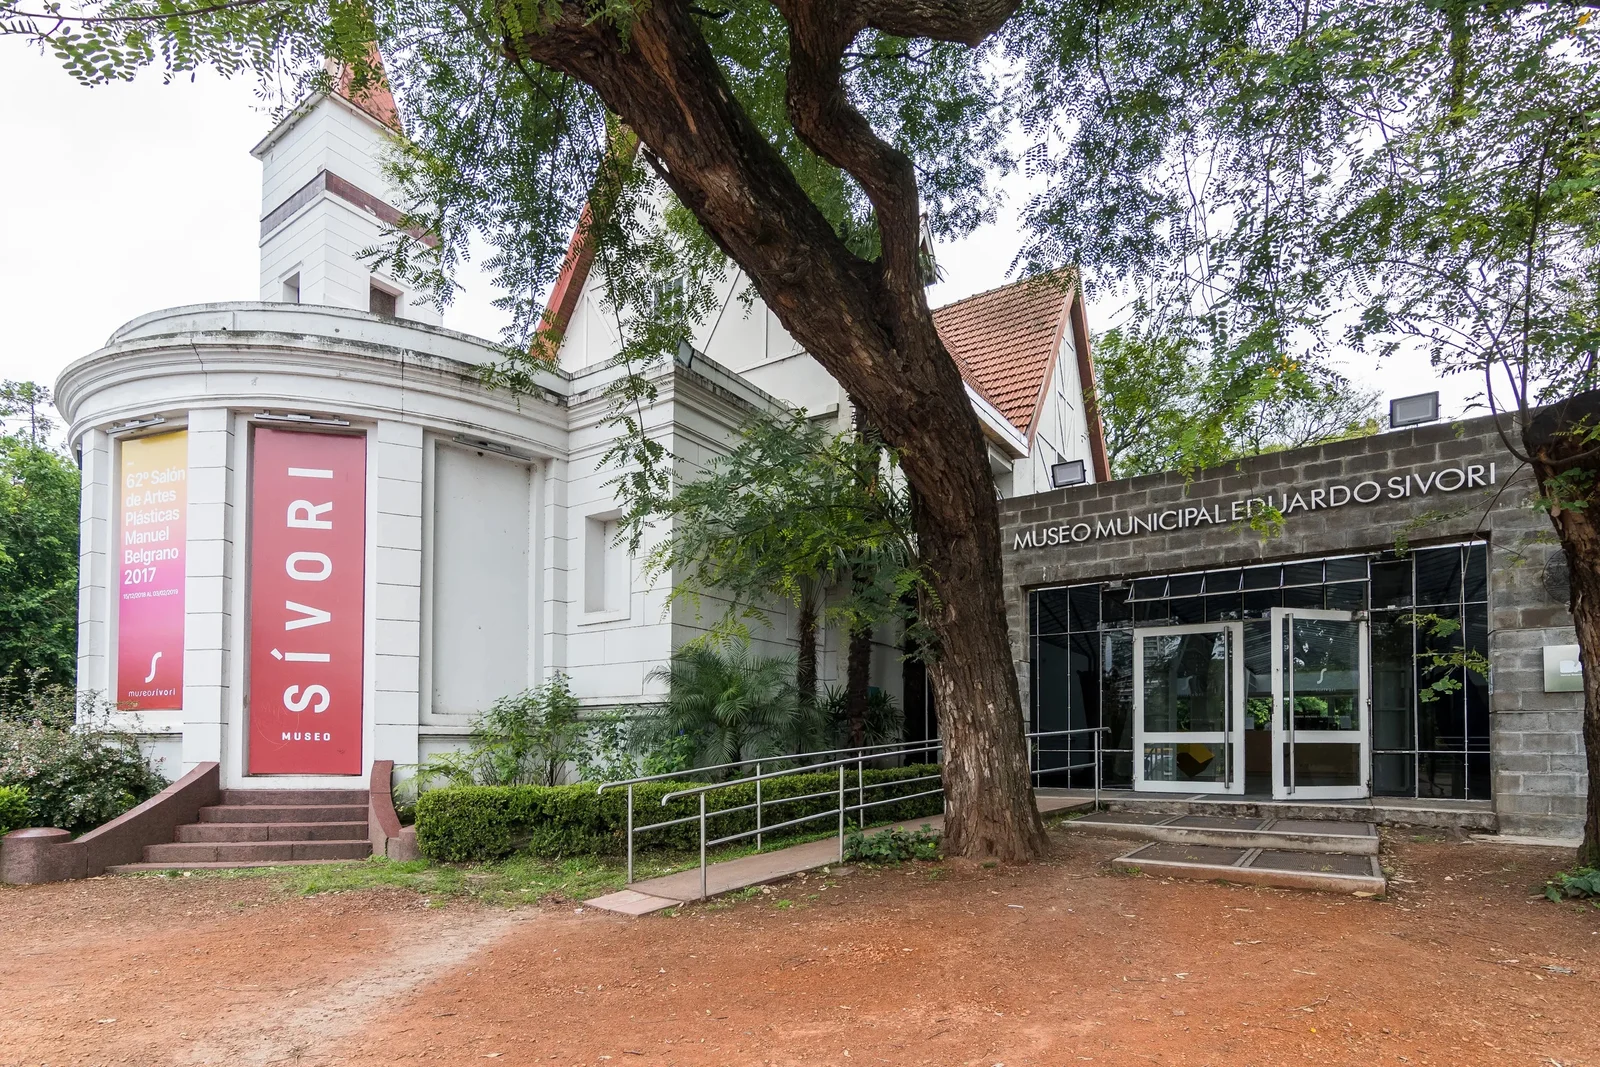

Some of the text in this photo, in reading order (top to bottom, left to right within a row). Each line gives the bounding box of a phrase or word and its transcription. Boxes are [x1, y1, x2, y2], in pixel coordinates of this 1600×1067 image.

[151, 466, 186, 485] Salón
[125, 489, 177, 508] de Artes
[1013, 462, 1496, 550] MUSEO MUNICIPAL EDUARDO SIVORI
[125, 508, 180, 527] Plásticas
[125, 526, 169, 546] Manuel
[124, 547, 179, 566] Belgrano
[124, 567, 157, 585] 2017
[270, 467, 333, 714] SÍVORI
[282, 732, 331, 741] MUSEO
